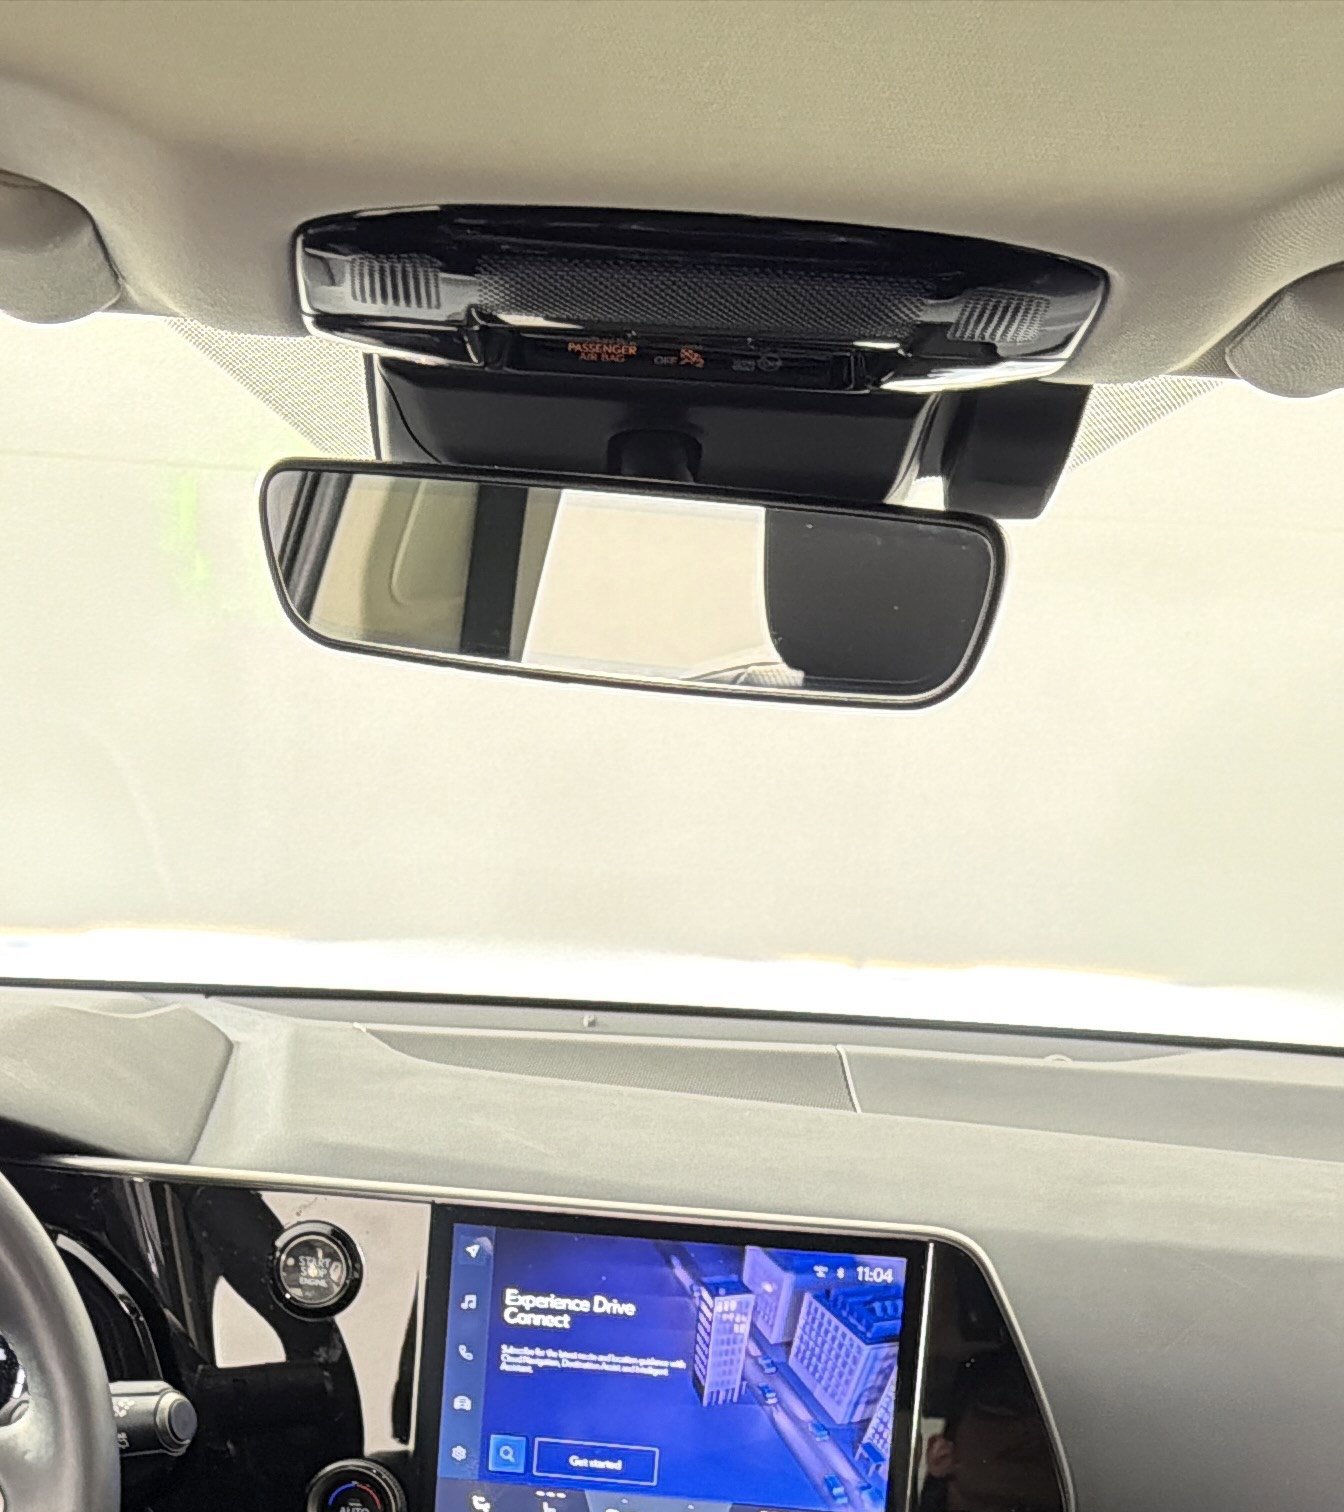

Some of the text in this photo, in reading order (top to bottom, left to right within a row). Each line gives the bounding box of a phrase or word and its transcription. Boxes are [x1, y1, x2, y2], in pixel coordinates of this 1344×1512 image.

[567, 341, 638, 356] PASSENGER
[300, 1266, 328, 1278] SP
[857, 1265, 894, 1283] 11:04
[504, 1287, 637, 1316] Experience Drive
[503, 1306, 571, 1329] Connect
[568, 1455, 623, 1471] Get started
